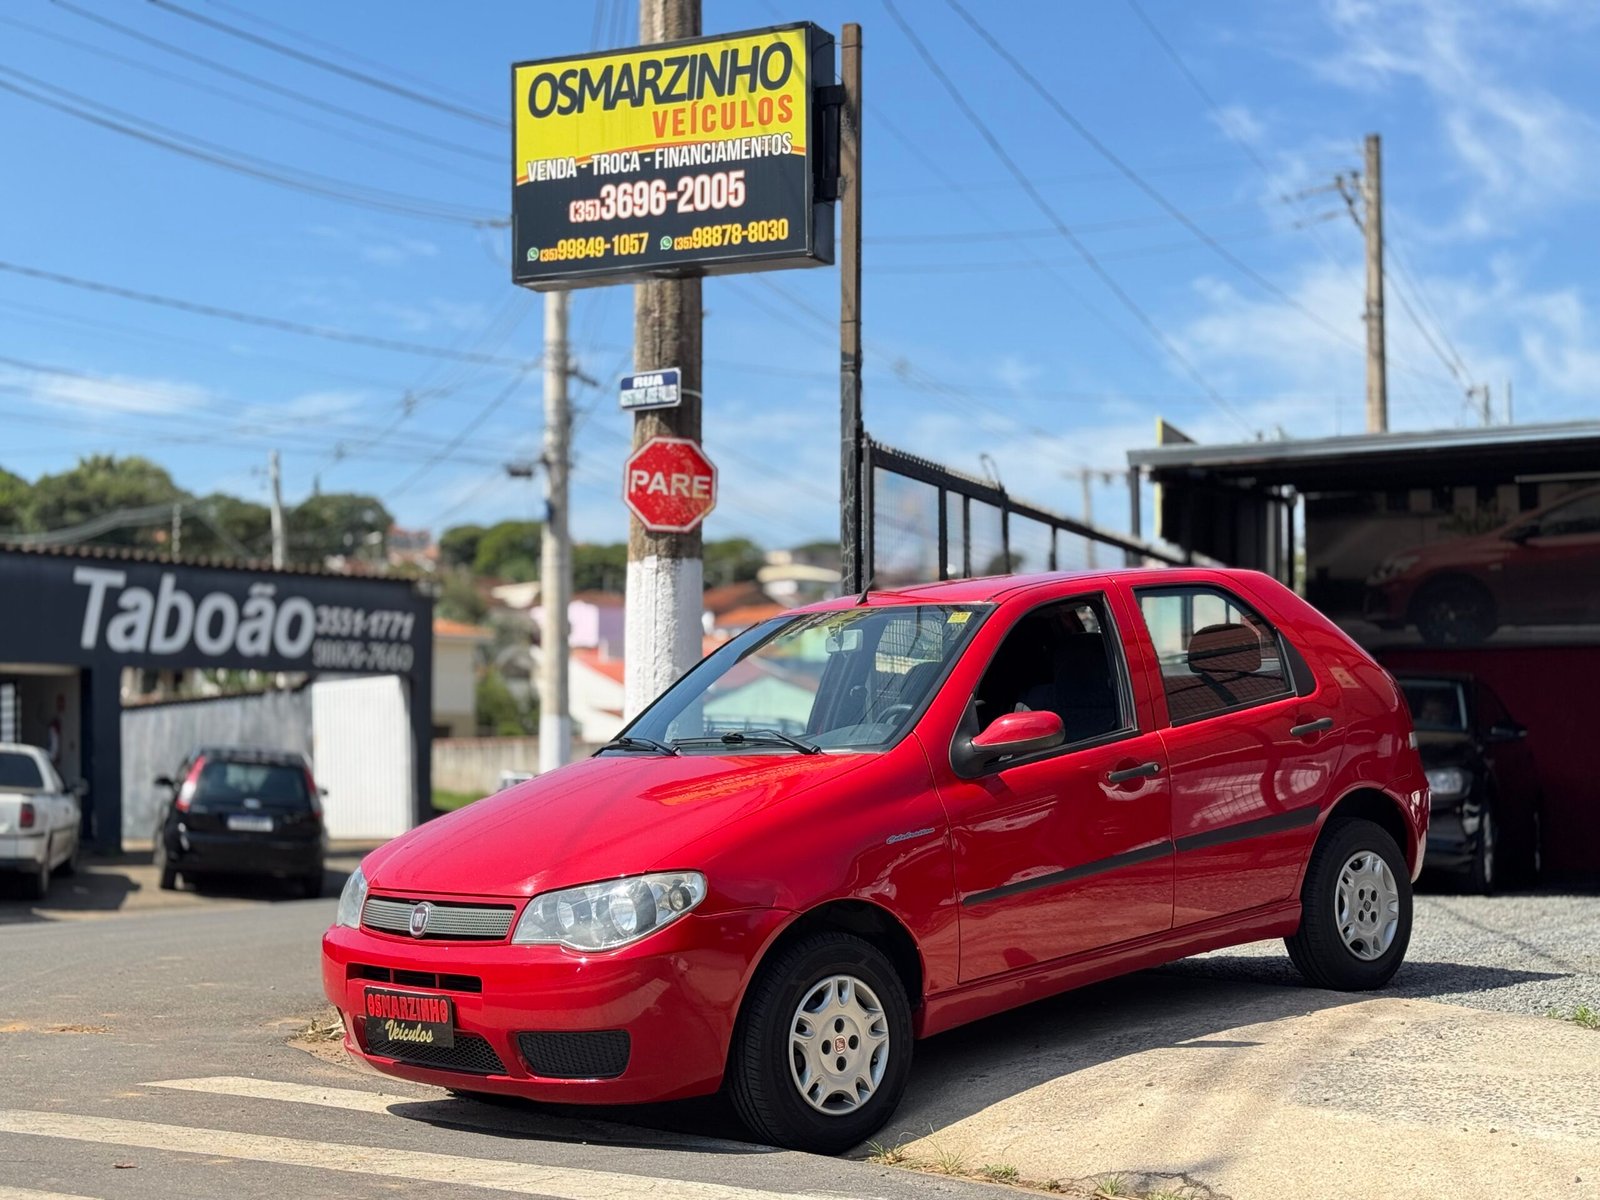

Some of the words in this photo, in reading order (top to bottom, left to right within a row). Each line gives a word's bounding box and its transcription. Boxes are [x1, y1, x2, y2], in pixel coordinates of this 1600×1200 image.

[528, 41, 792, 118] OSMARZINHO
[652, 94, 793, 138] VEÍCULOS
[527, 161, 577, 181] VENDA
[591, 151, 640, 175] TROCA
[655, 133, 792, 169] FINANCIAMENTOS
[633, 374, 664, 389] RUA
[630, 470, 711, 499] PARE
[73, 567, 315, 658] Taboão
[367, 993, 448, 1023] OSMARZINHO
